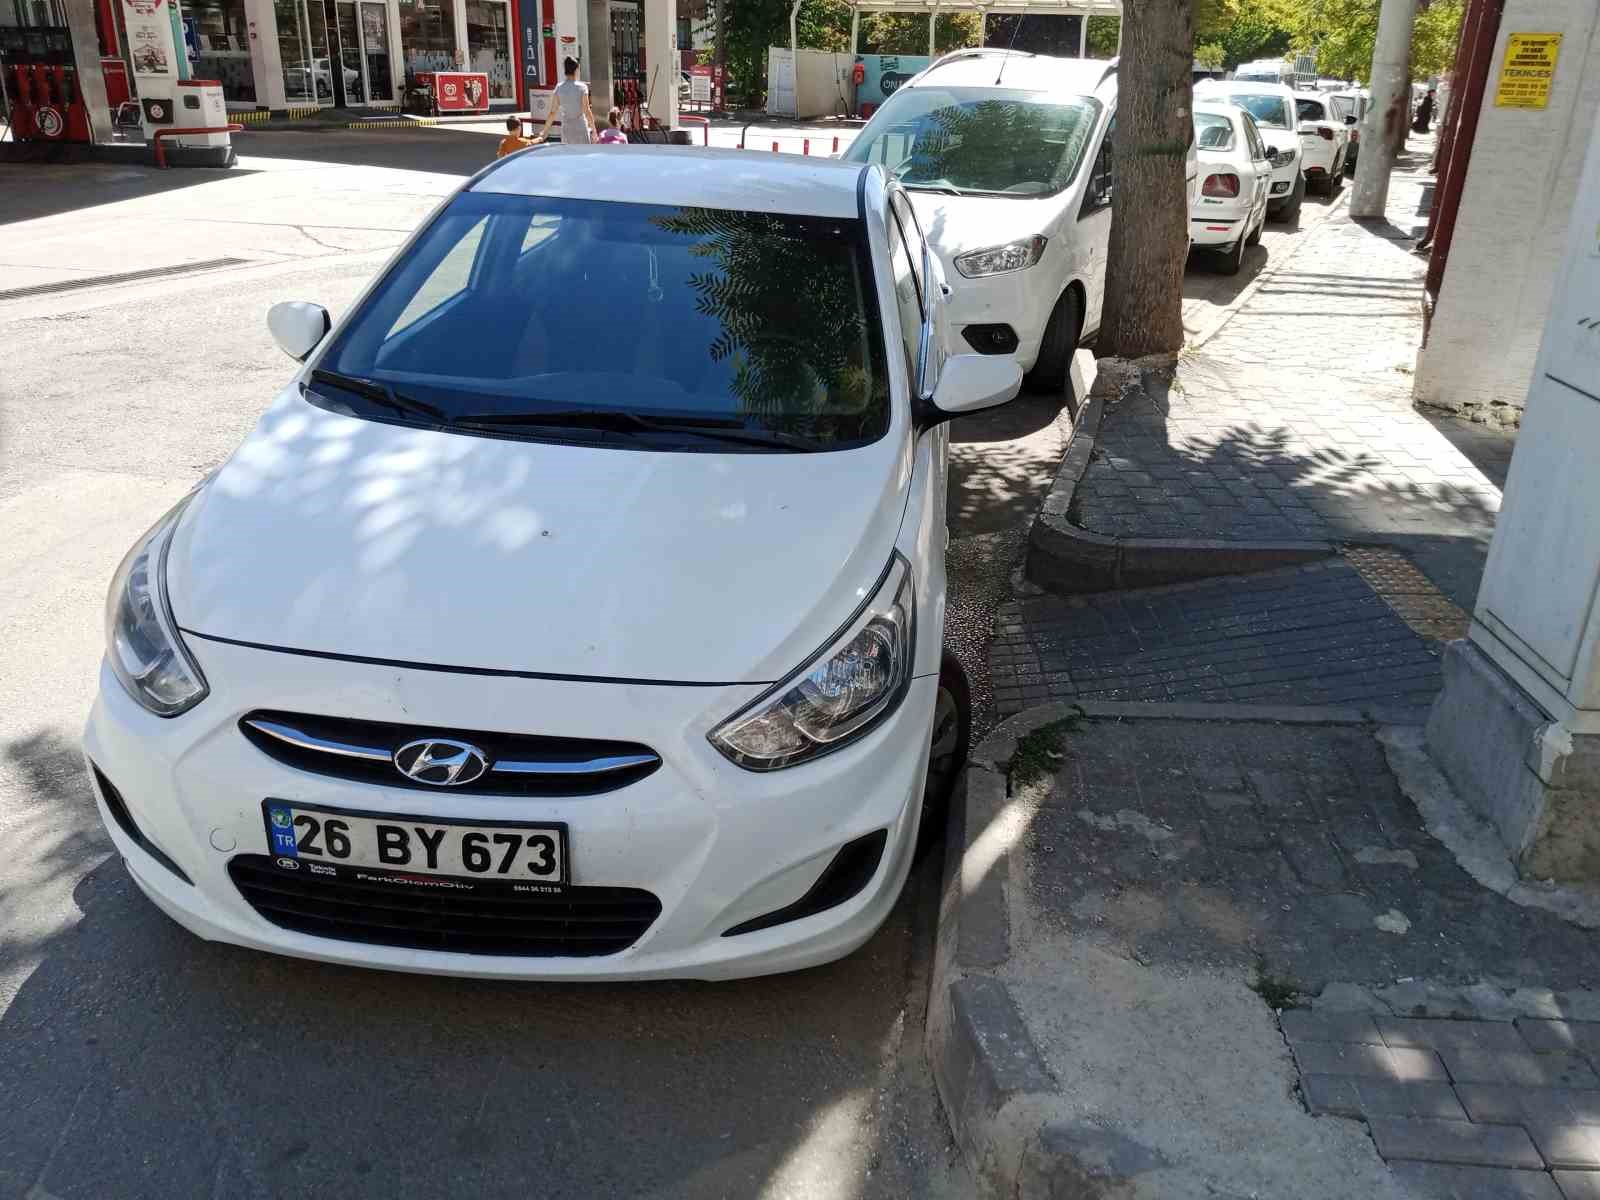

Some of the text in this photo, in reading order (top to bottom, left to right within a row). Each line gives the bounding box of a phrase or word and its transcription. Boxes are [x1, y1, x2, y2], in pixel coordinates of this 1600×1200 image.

[276, 833, 294, 848] TR
[294, 814, 556, 876] 26 BY 673
